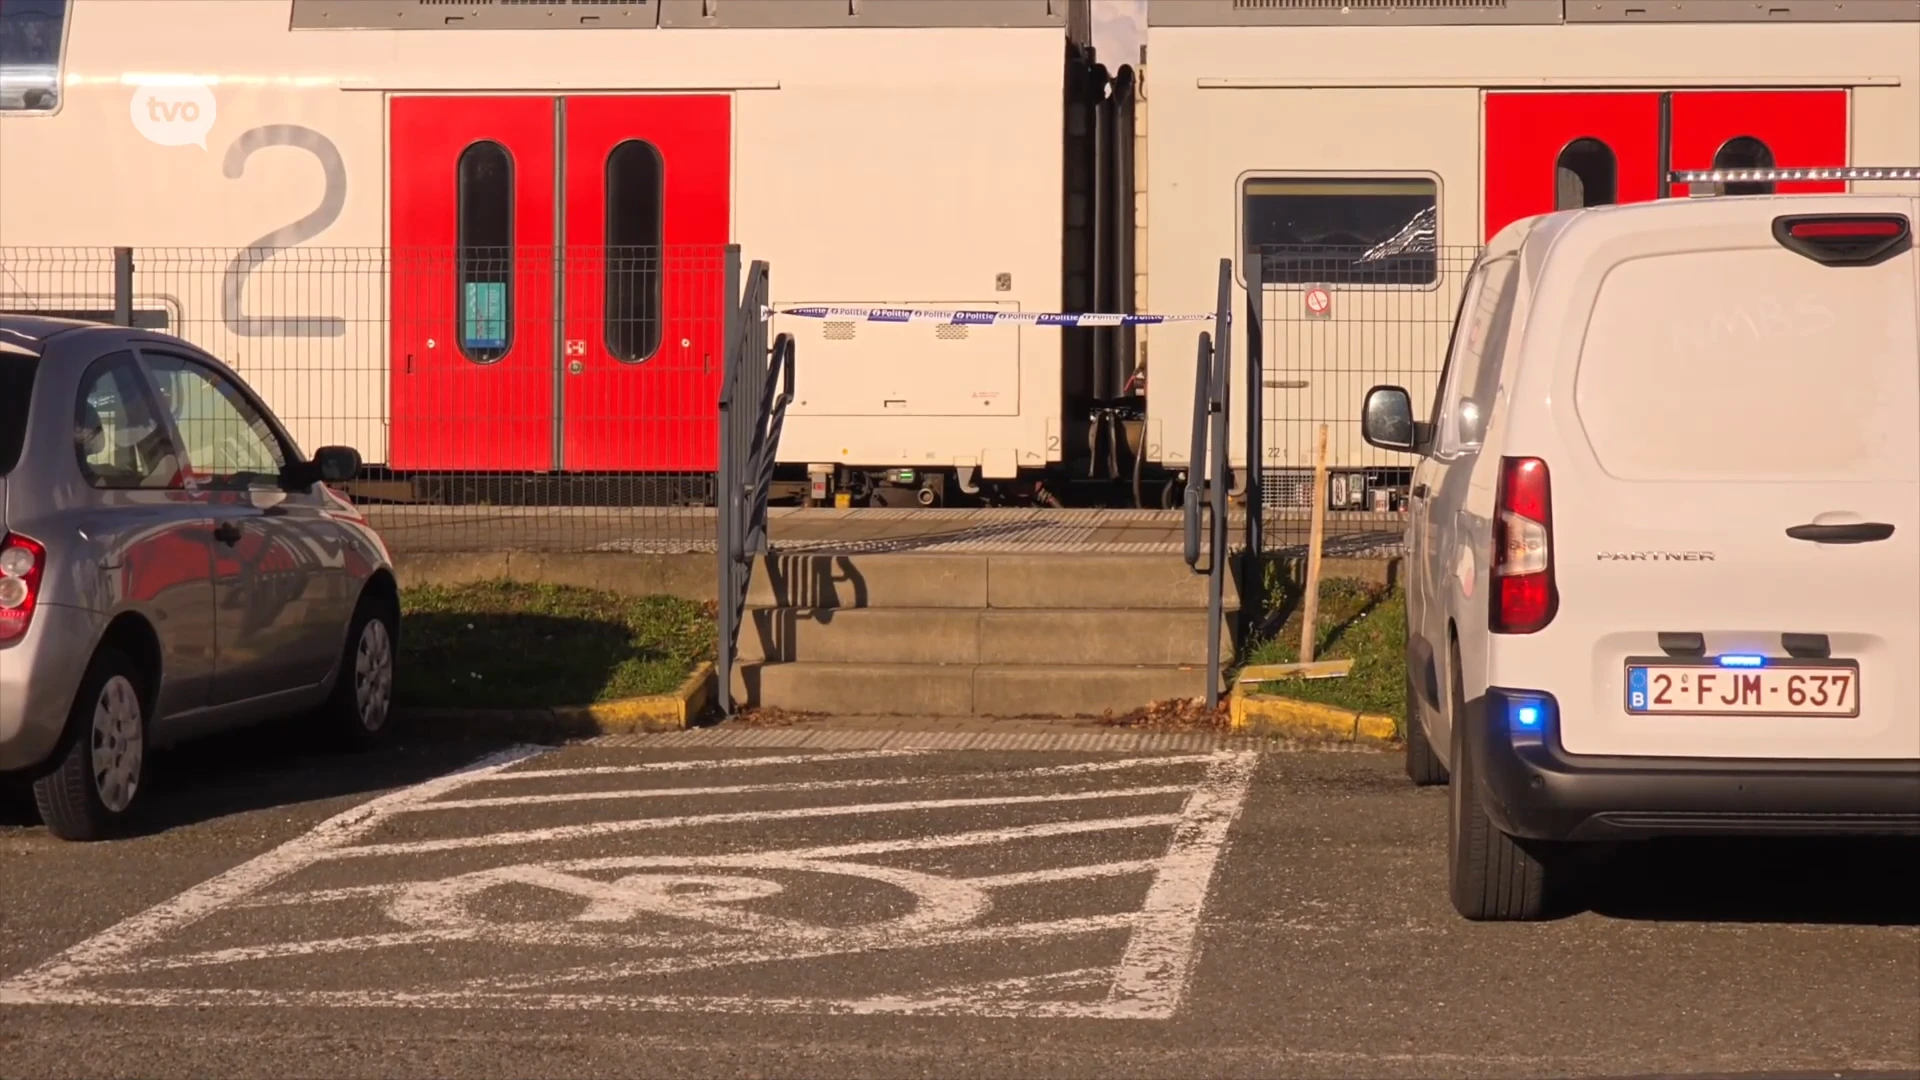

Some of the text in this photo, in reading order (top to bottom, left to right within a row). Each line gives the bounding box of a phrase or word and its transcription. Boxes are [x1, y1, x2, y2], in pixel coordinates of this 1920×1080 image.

[221, 124, 347, 337] 2
[840, 308, 868, 316] Politie
[882, 309, 910, 317] Politie
[923, 310, 952, 318] Politie
[966, 312, 994, 320] Politie
[1048, 436, 1060, 451] 2
[1149, 444, 1160, 459] 2
[1597, 551, 1715, 561] PARTNER
[1653, 674, 1850, 706] 2-FJM-637
[1632, 692, 1644, 706] B
